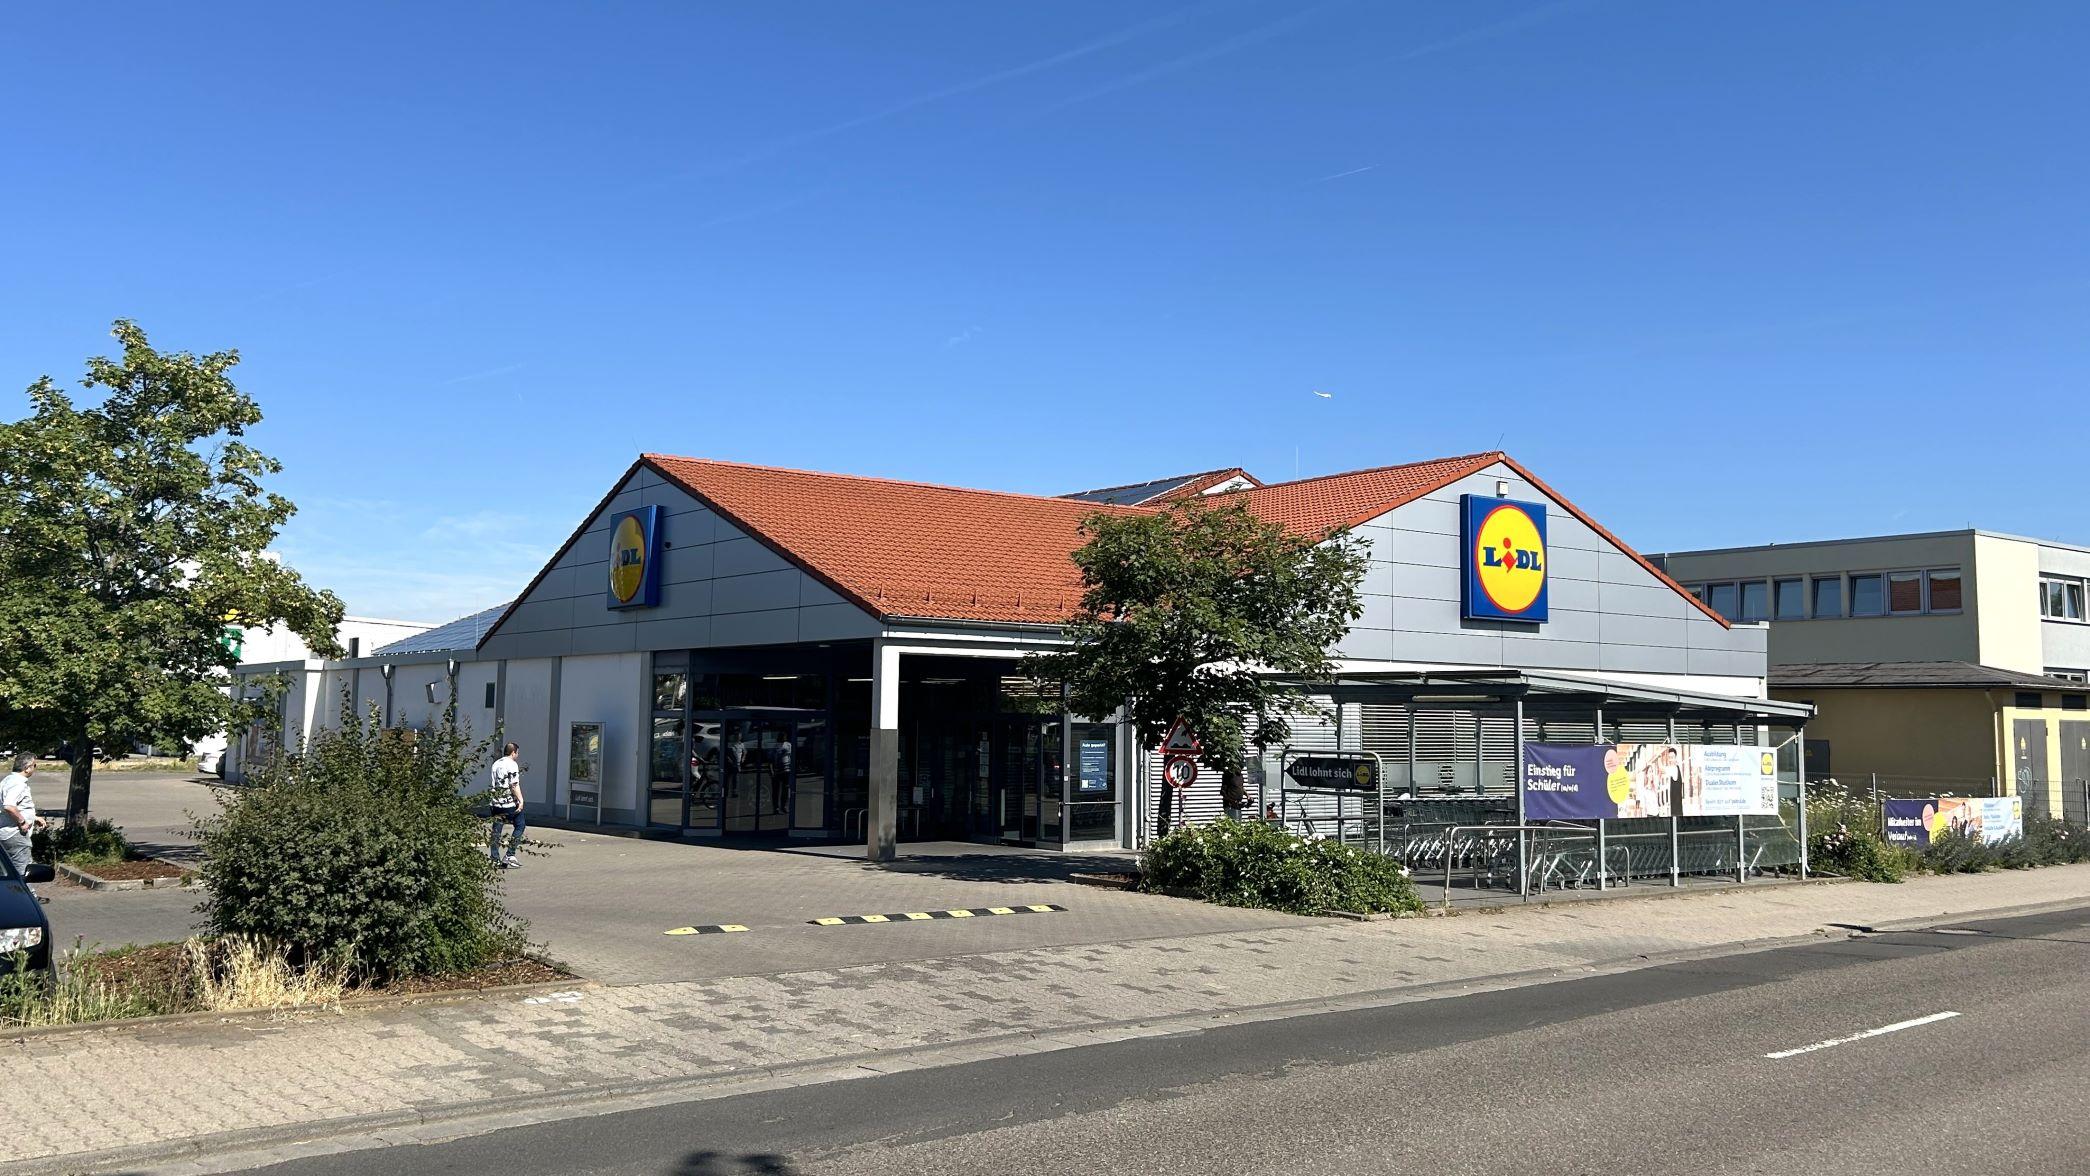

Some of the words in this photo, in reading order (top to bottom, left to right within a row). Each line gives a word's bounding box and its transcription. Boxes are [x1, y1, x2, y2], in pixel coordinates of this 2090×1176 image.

[1173, 765, 1190, 780] 10
[1292, 766, 1308, 776] Lidl
[1309, 767, 1332, 777] lohnt
[1334, 768, 1352, 779] sich
[1527, 764, 1561, 779] Einstieg
[1563, 764, 1576, 776] für
[1527, 779, 1560, 791] Schüler
